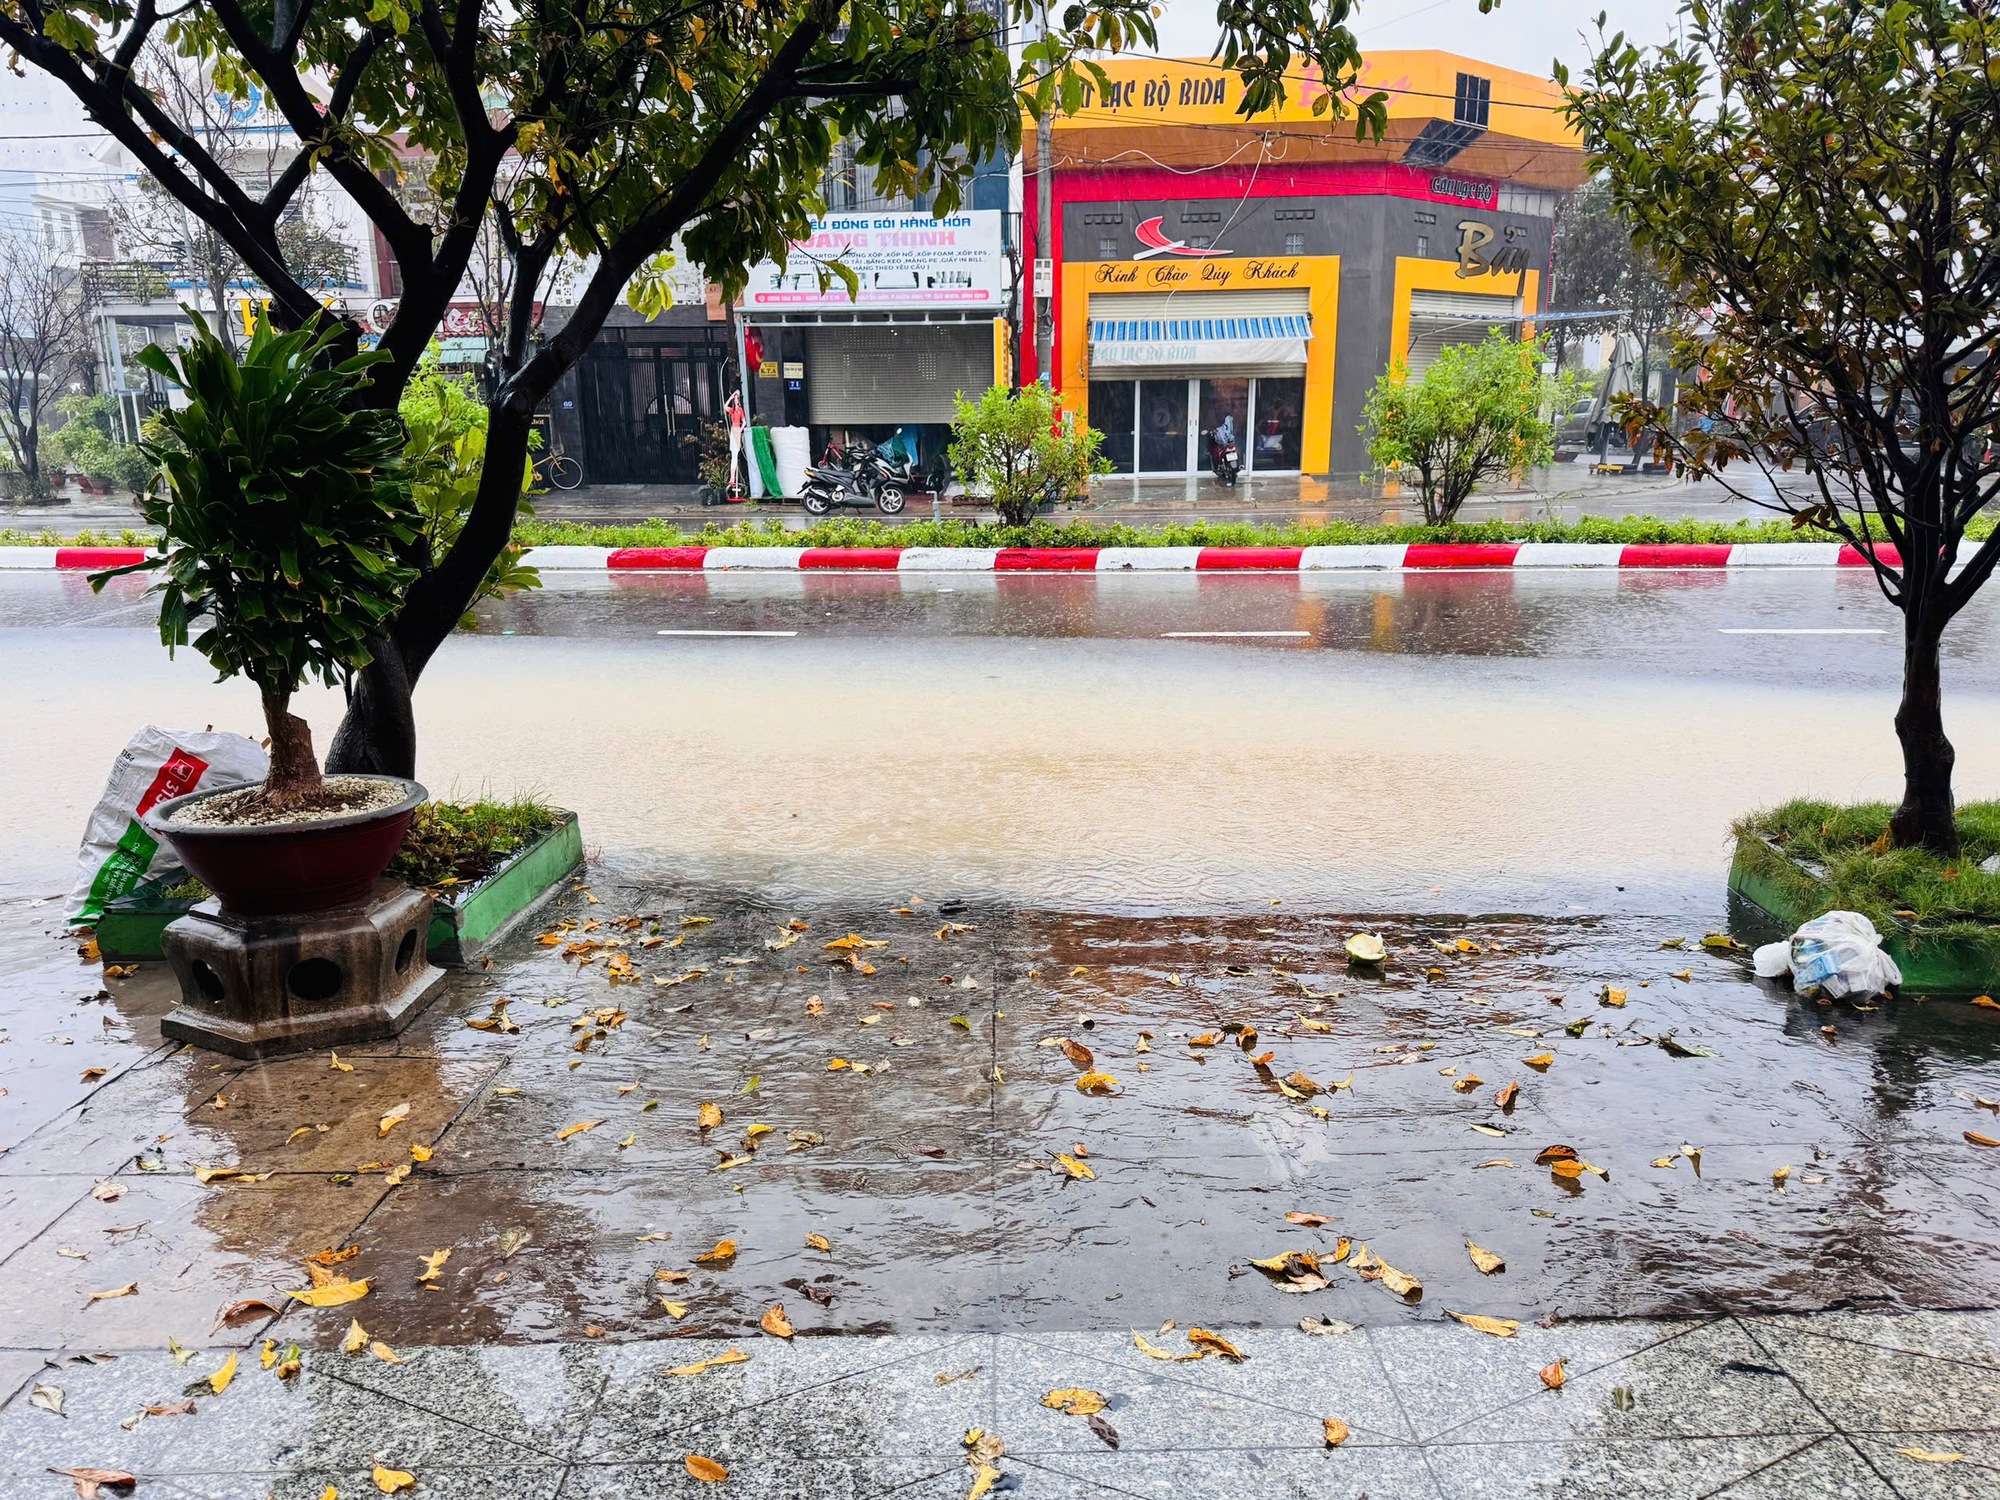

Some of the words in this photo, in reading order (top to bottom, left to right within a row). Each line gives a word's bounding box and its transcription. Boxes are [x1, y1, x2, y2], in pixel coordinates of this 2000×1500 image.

[1144, 74, 1171, 112] BỘ
[1179, 78, 1226, 105] BIDA
[831, 218, 868, 230] ĐÓNG
[873, 217, 895, 229] GÓI
[900, 216, 938, 228] HÀNG
[942, 216, 971, 228] HÓA
[1095, 264, 1139, 283] Kính
[1147, 265, 1190, 289] Chào
[1243, 260, 1300, 280] Khách
[1455, 220, 1530, 297] Bảy
